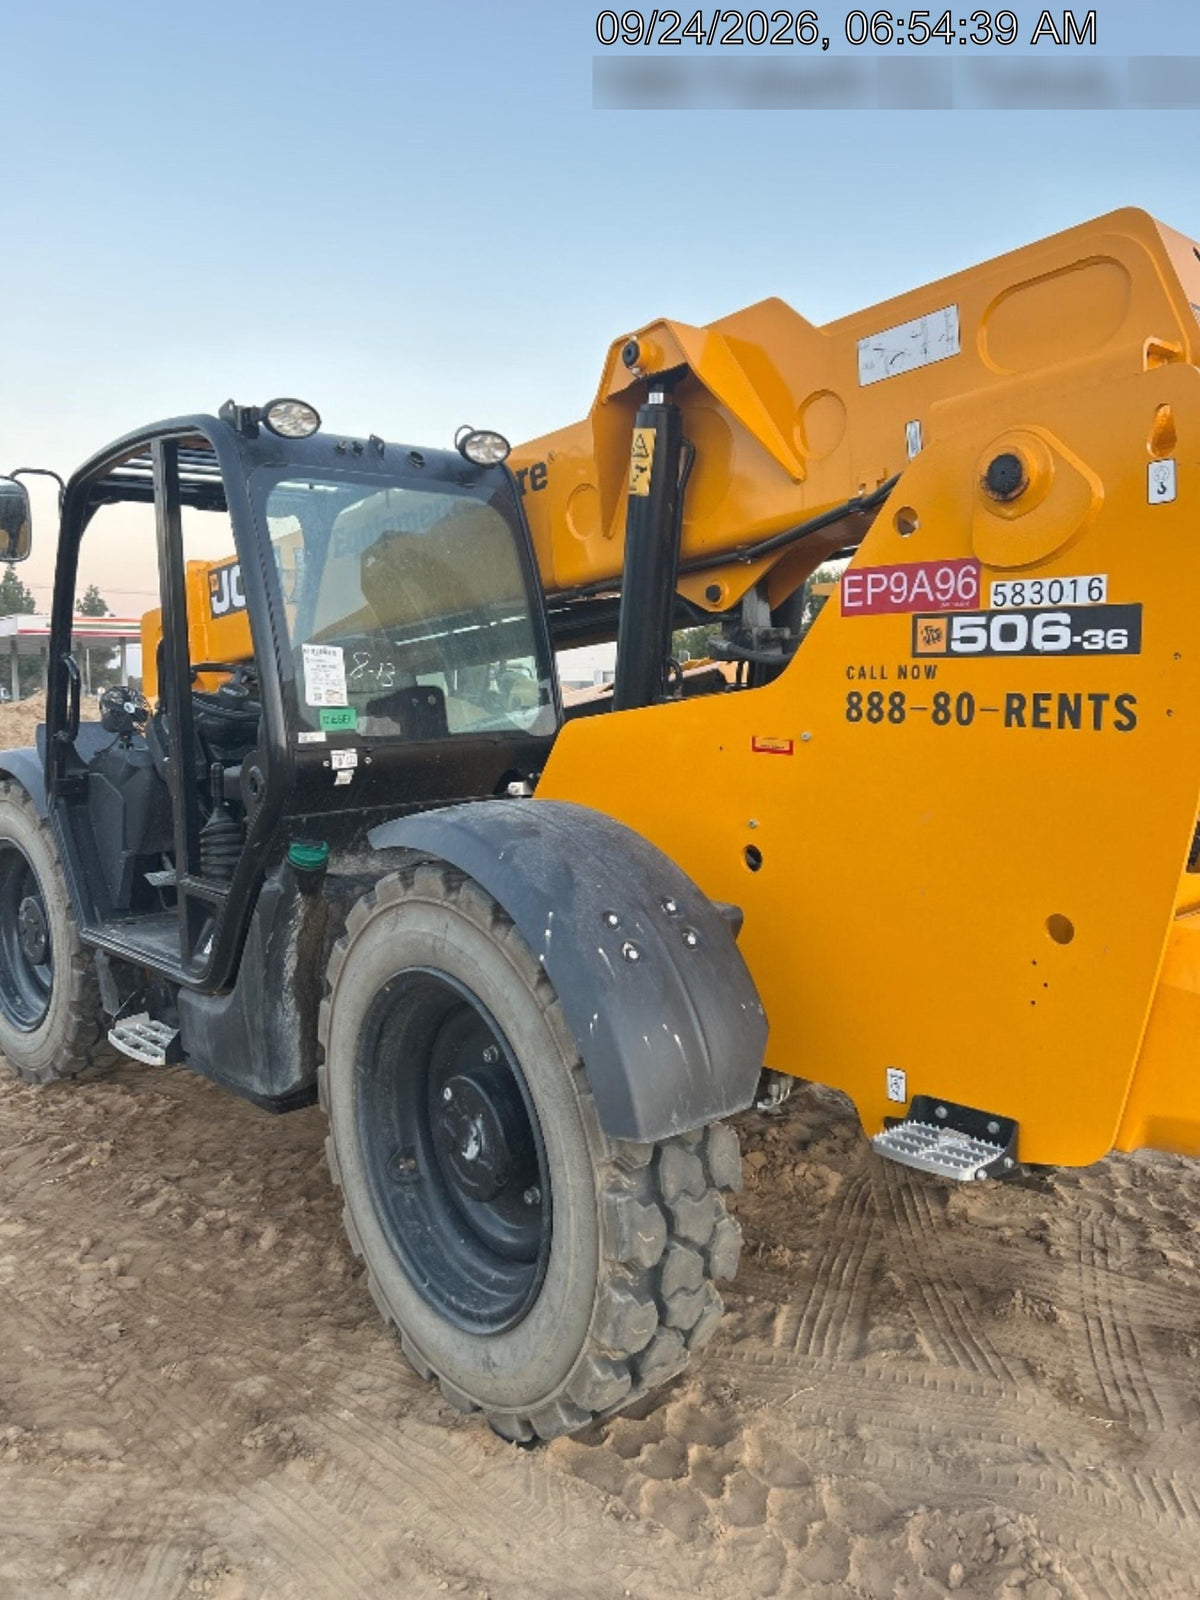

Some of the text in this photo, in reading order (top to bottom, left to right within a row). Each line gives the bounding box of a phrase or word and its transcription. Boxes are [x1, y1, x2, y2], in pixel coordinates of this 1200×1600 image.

[211, 564, 246, 614] JC
[842, 565, 978, 608] EP9A96
[992, 577, 1104, 607] 583016
[950, 612, 1129, 654] 506-36
[846, 664, 939, 680] CALL NOW
[846, 690, 1138, 732] 888-80-RENTS
